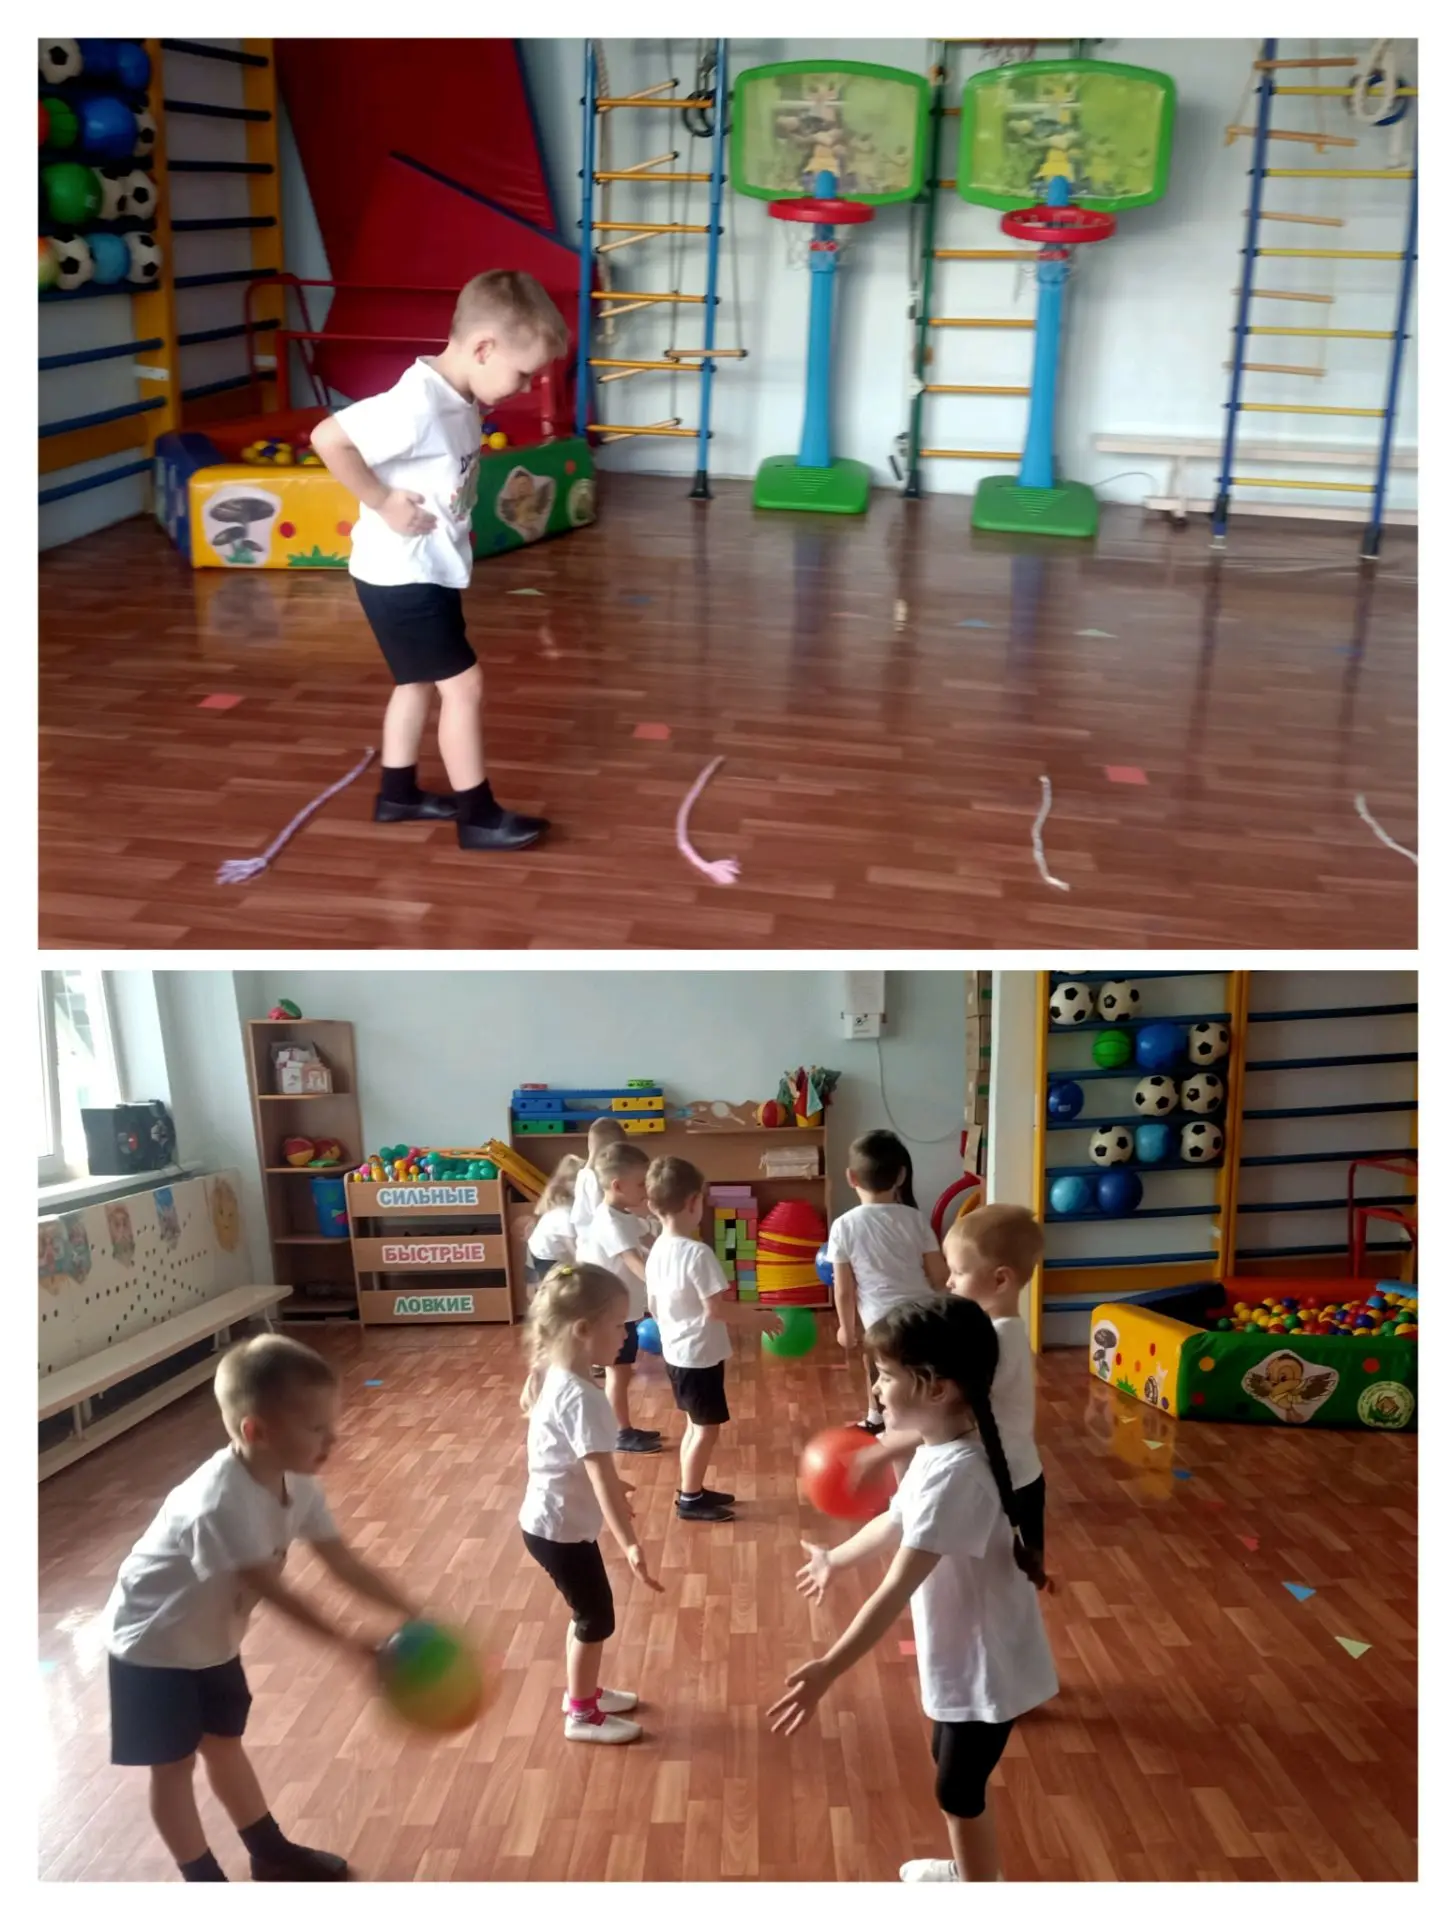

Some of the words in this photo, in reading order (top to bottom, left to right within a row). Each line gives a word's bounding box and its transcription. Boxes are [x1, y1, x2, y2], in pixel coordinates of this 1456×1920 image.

[378, 1187, 477, 1206] СИЛЬНЫЕ
[383, 1244, 484, 1262] БЫСТРЫЕ
[395, 1296, 473, 1314] ЛОВКИЕ
